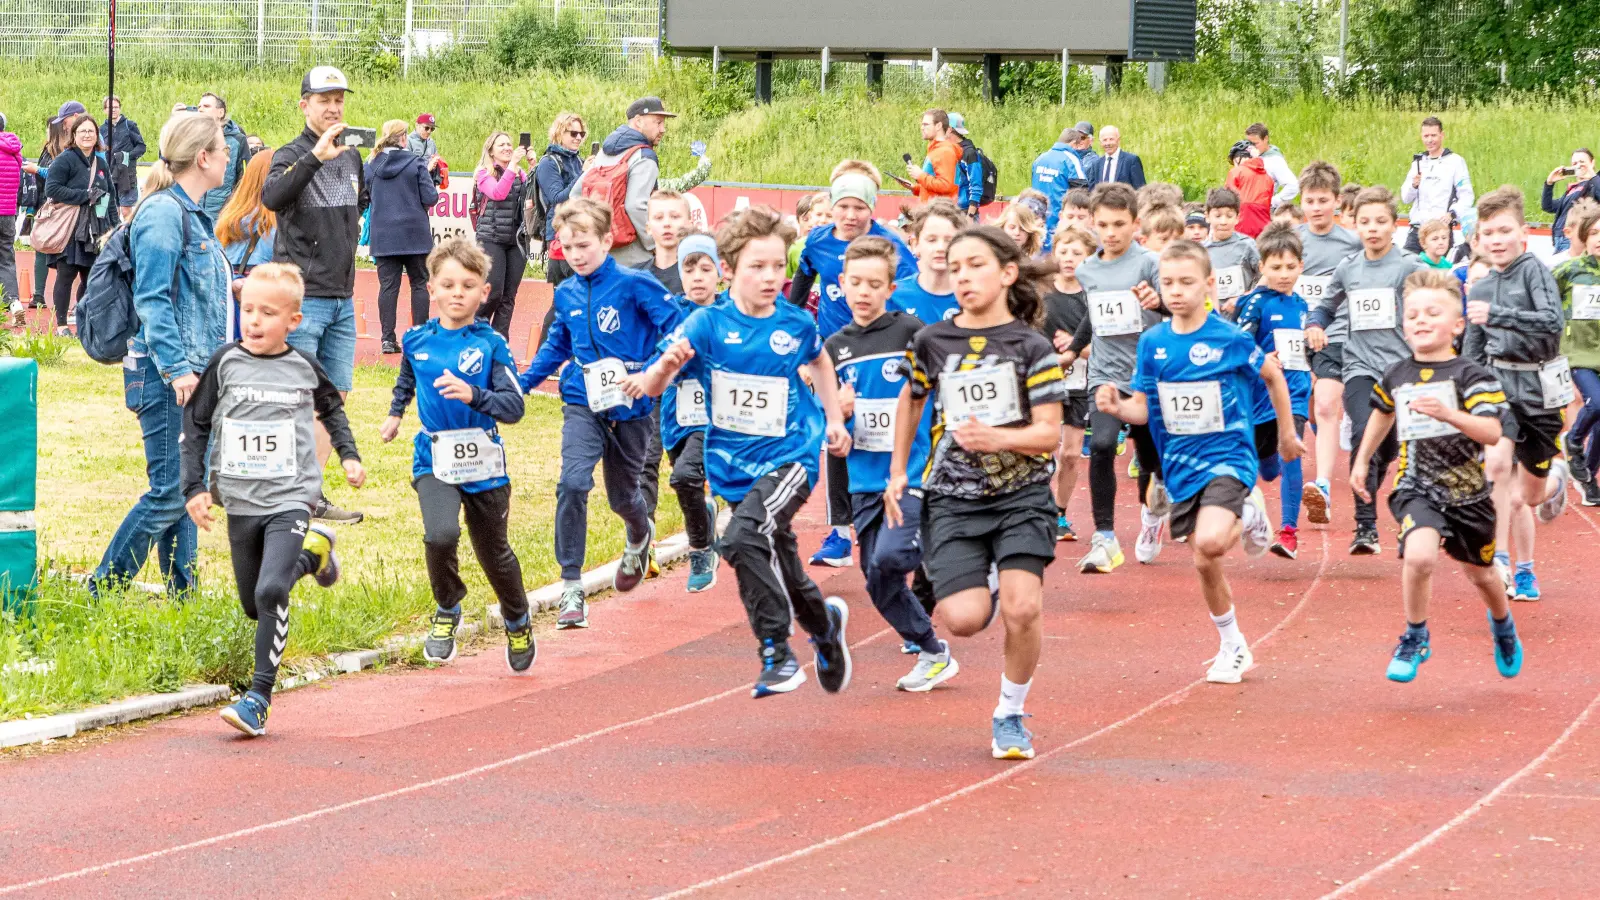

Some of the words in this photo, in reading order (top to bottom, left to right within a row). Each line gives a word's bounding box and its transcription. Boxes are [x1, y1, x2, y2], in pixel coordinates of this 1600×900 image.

[1300, 284, 1322, 295] 139
[1097, 302, 1124, 316] 141
[1355, 298, 1381, 312] 160
[600, 370, 616, 387] 82
[247, 386, 302, 404] hummel
[729, 389, 768, 409] 125
[957, 381, 997, 403] 103
[1170, 395, 1203, 411] 129
[862, 412, 890, 428] 130
[238, 434, 277, 452] 115
[453, 442, 479, 459] 89
[246, 454, 268, 462] DAVID
[451, 459, 484, 469] JONATHAN
